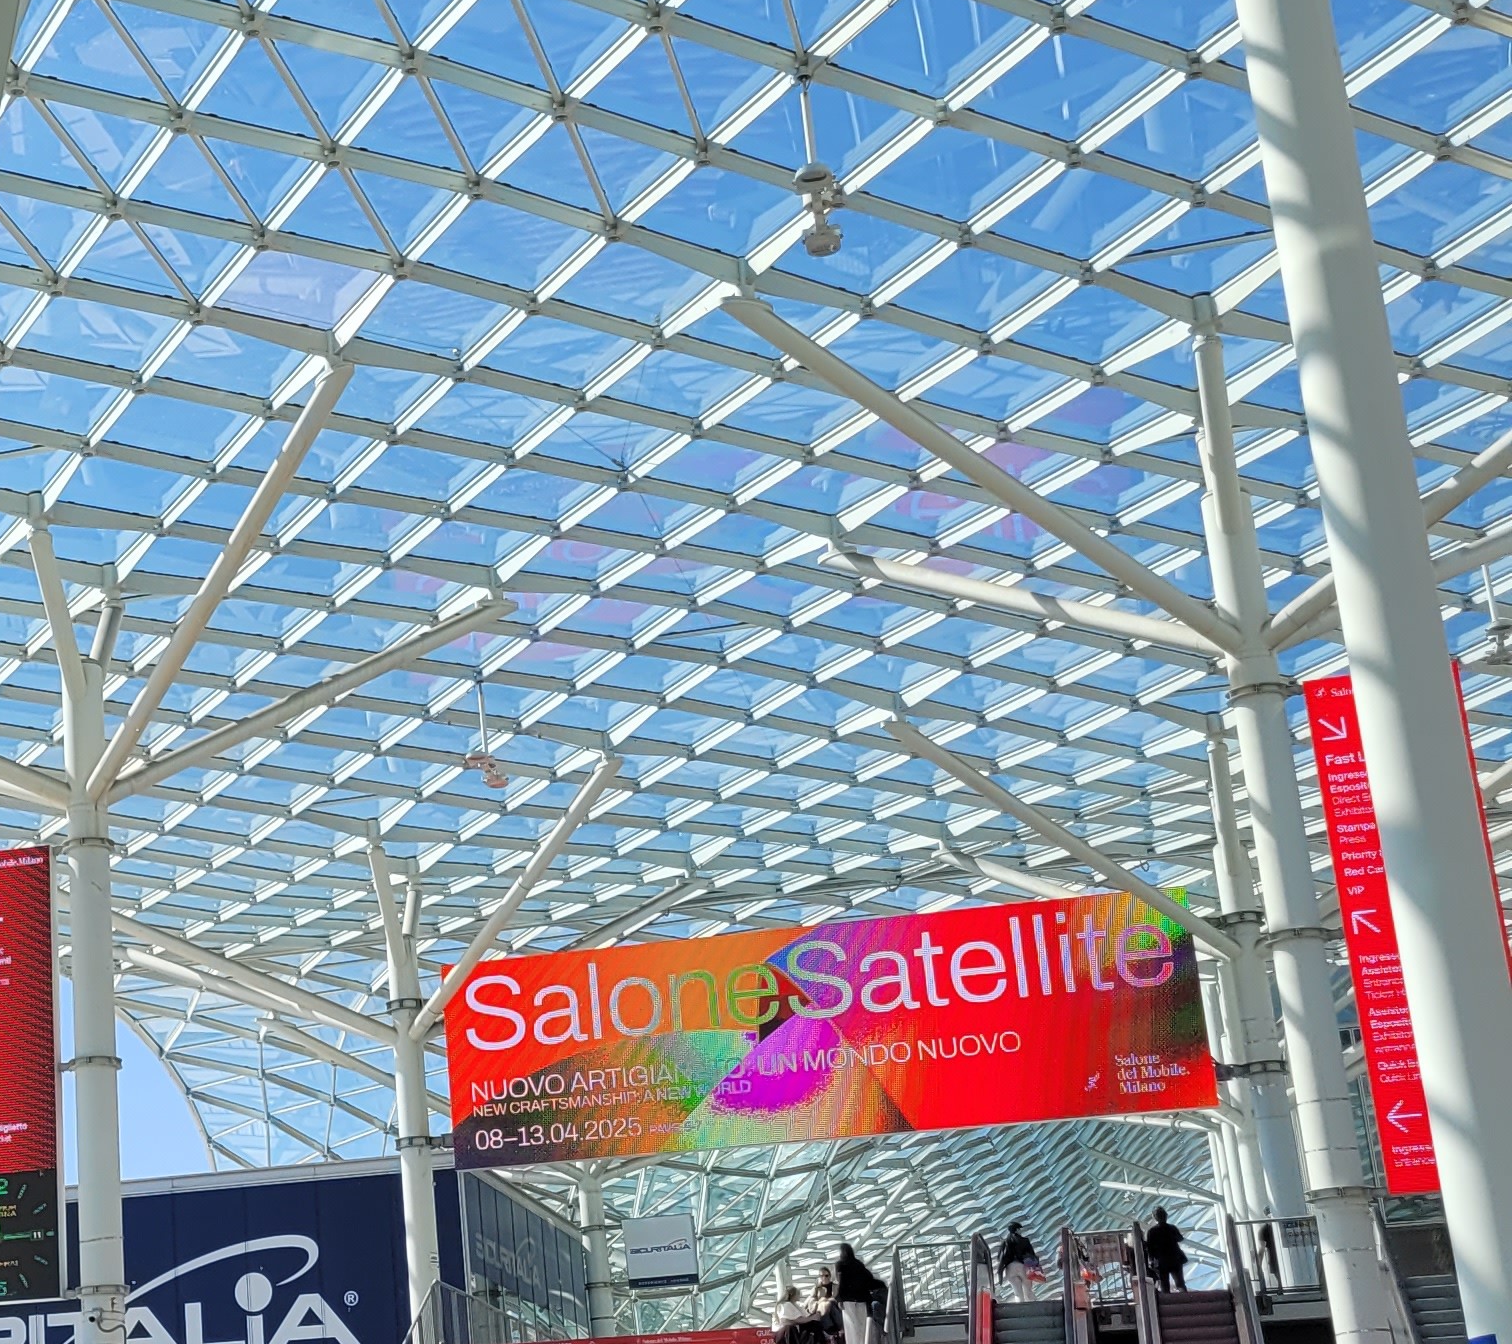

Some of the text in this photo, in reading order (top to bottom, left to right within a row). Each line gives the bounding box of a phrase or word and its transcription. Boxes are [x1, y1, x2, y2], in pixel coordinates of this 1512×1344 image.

[1325, 753, 1355, 767] Fast
[1336, 822, 1375, 833] Stampa
[1339, 834, 1366, 844] Press
[1341, 849, 1377, 861] Priority
[1344, 866, 1365, 876] Red
[1347, 885, 1365, 896] VIP
[465, 912, 1174, 1051] SaloneSatellite
[471, 1073, 564, 1103] NUOVO
[758, 1049, 797, 1077] UN
[804, 1042, 911, 1072] MONDO
[918, 1030, 1021, 1061] NUOVO
[1119, 1080, 1166, 1094] Milano
[472, 1103, 507, 1118] NEW
